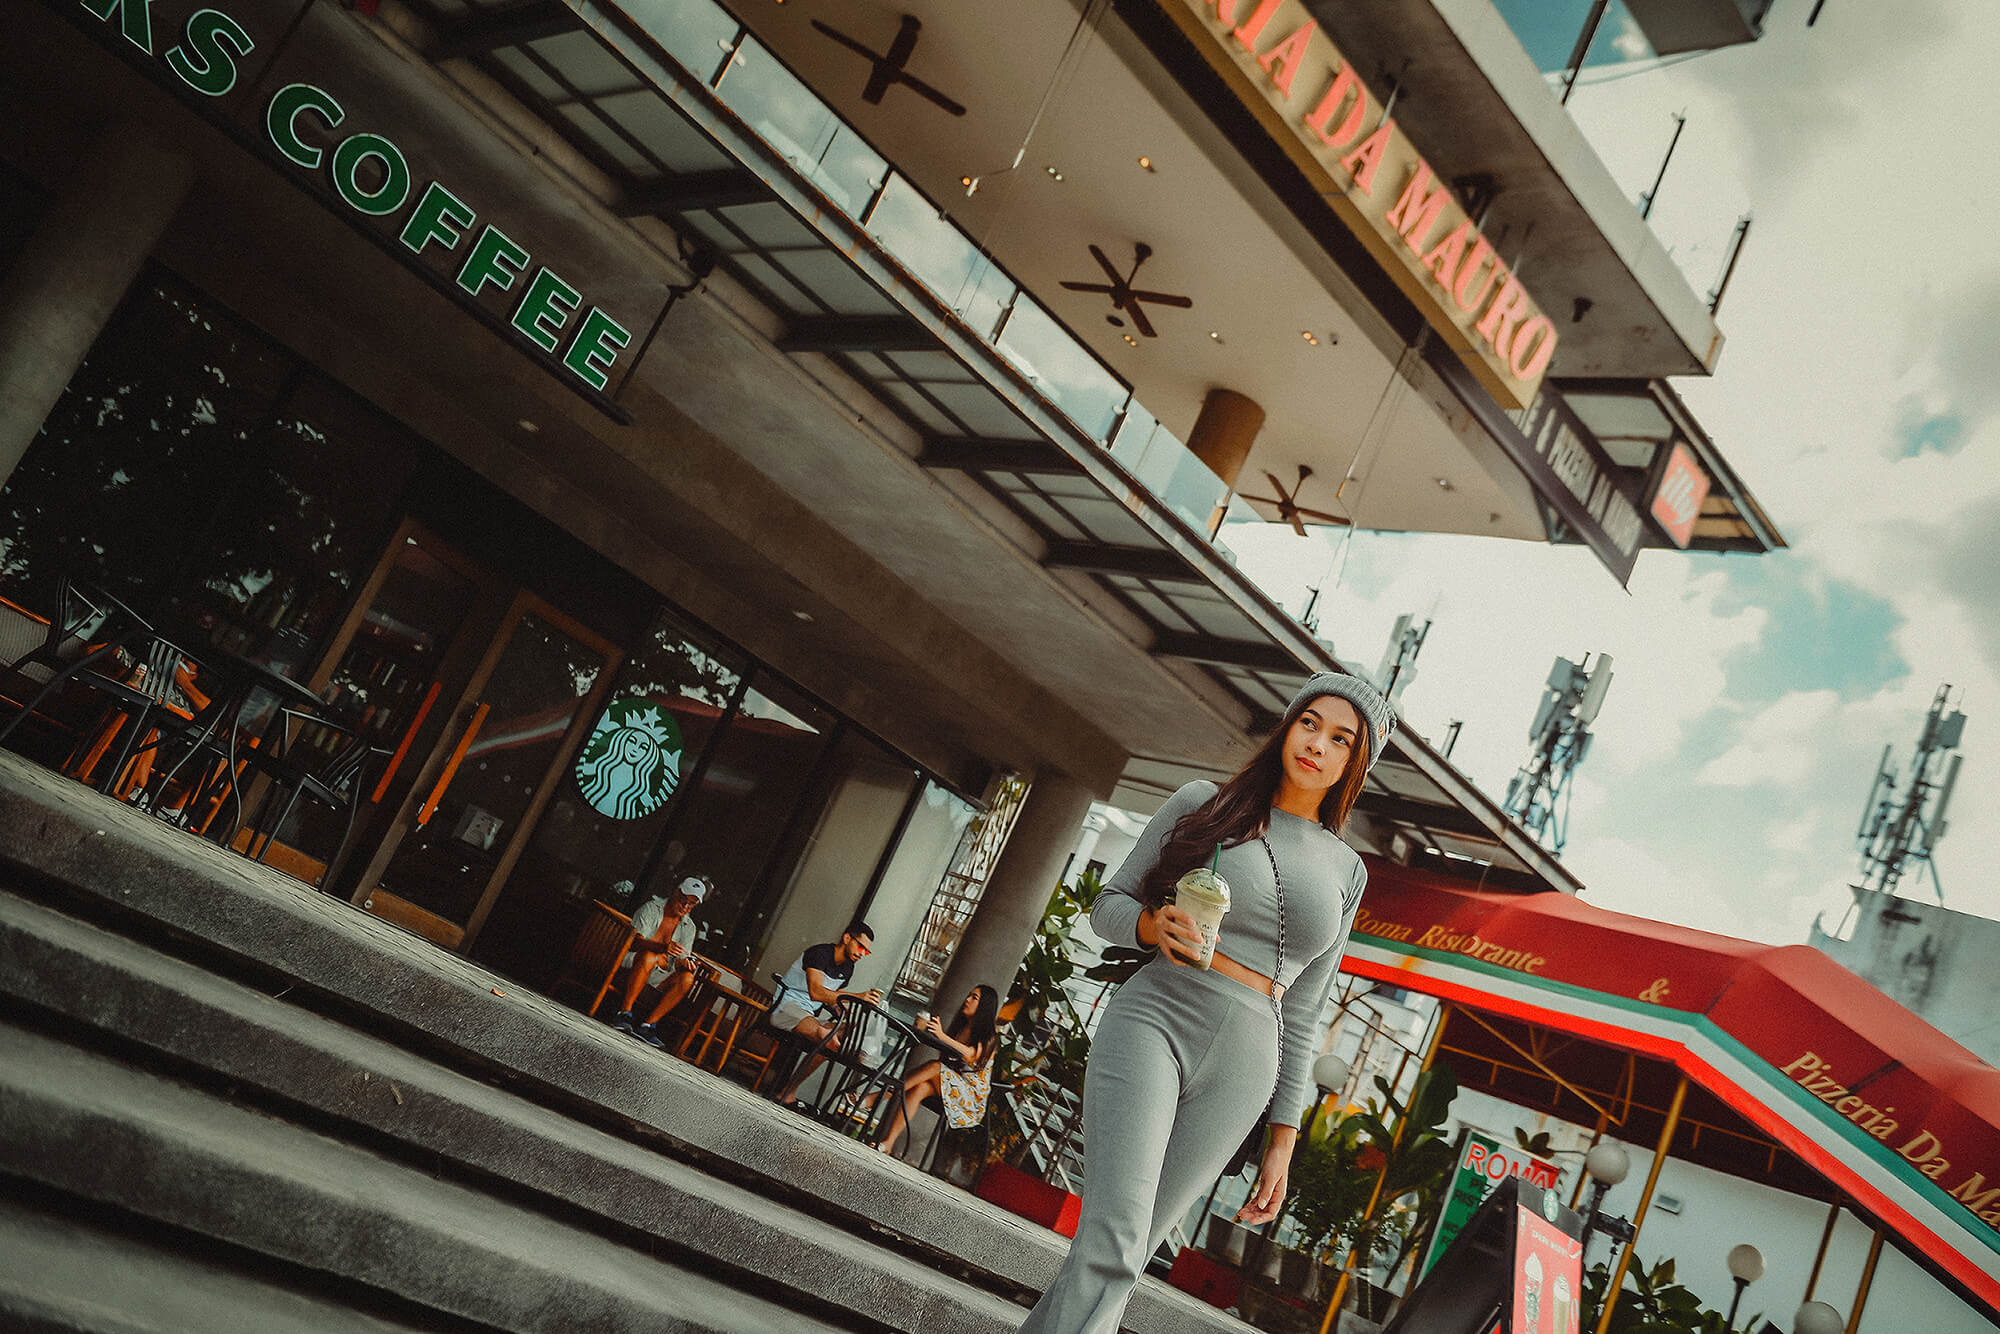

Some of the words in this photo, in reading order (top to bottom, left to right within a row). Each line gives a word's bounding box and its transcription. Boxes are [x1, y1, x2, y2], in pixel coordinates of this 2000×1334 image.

[267, 83, 632, 392] COFFEE
[1303, 60, 1396, 197] DA
[1385, 157, 1559, 381] MAURO
[1352, 908, 1413, 941] Roma
[1415, 924, 1546, 974] Ristorante
[1638, 978, 1669, 1003] &
[1779, 1051, 1899, 1140] Pizzeria
[1896, 1129, 1950, 1180] Da
